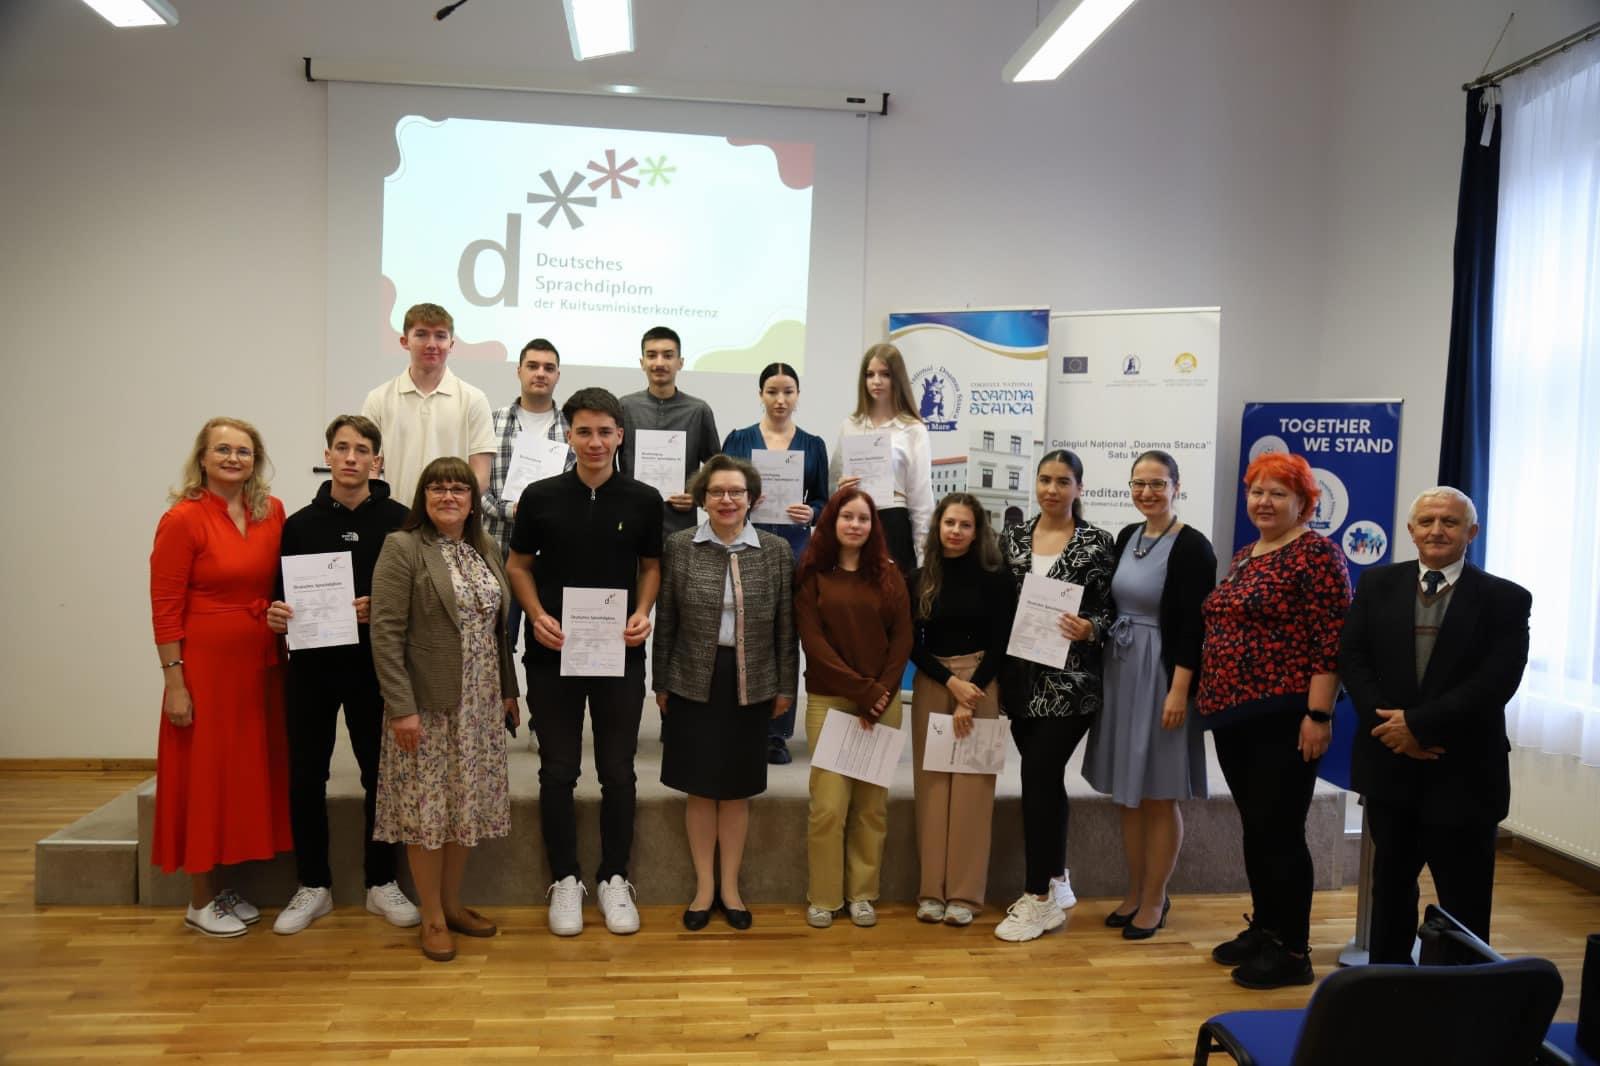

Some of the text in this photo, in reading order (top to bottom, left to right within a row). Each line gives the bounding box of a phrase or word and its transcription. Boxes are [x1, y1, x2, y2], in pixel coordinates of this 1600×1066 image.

[536, 252, 623, 272] Deutsches
[535, 275, 654, 298] Sprachdiplom
[533, 298, 719, 319] der Kultusministerkonferenz
[971, 390, 1034, 401] DOAMNA
[969, 402, 1033, 415] STANCA
[1280, 418, 1371, 434] TOGETHER
[1051, 440, 1088, 450] Colegiul
[1304, 438, 1393, 453] WE STAND
[1107, 451, 1129, 459] Satu
